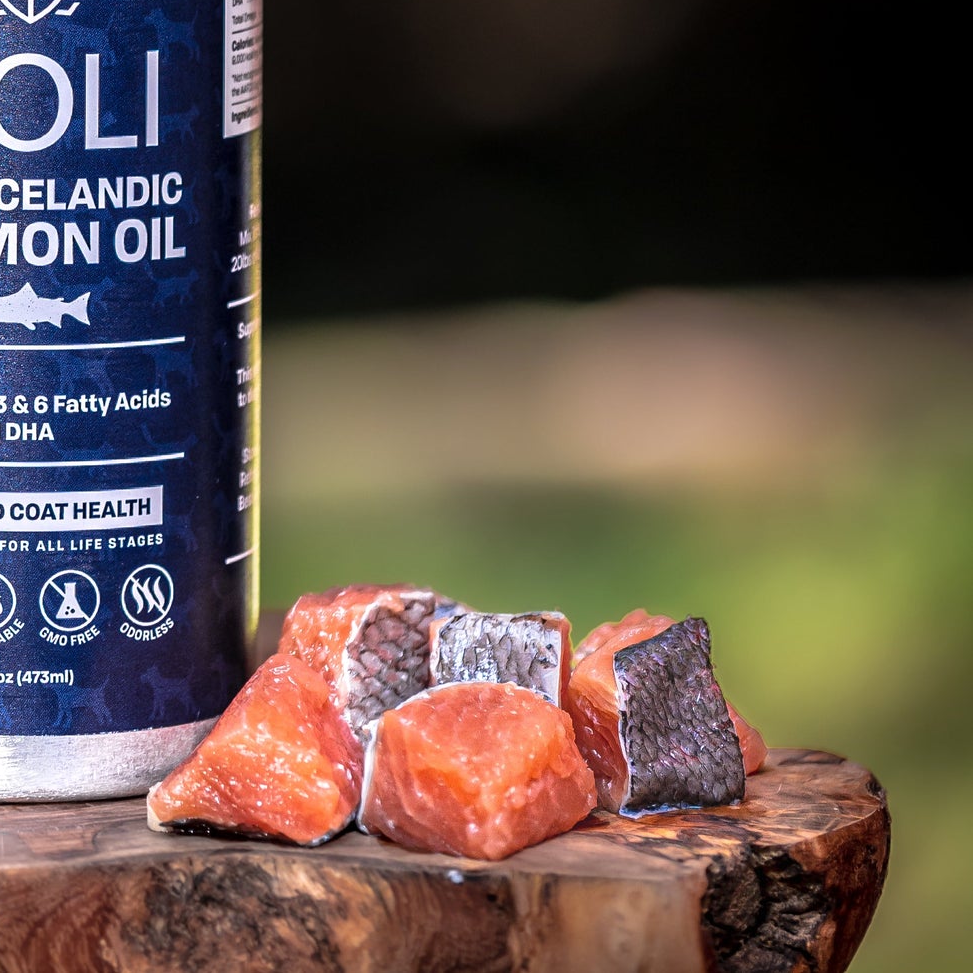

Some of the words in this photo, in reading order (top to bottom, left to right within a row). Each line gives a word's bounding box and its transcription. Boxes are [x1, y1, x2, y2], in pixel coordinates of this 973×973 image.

[114, 216, 186, 263] OIL
[12, 395, 29, 414] &
[33, 395, 48, 414] 6
[53, 394, 111, 417] Fatty
[115, 388, 171, 411] Acids
[5, 422, 55, 441] DHA
[9, 502, 68, 521] COAT
[73, 497, 151, 520] HEALTH
[0, 540, 30, 552] FOR
[36, 539, 65, 552] ALL
[70, 538, 103, 551] LIFE
[108, 533, 164, 549] STAGES
[39, 626, 69, 647] GMO
[70, 624, 101, 646] FREE
[119, 617, 175, 642] ODORLESS
[16, 669, 75, 687] (473ml)
